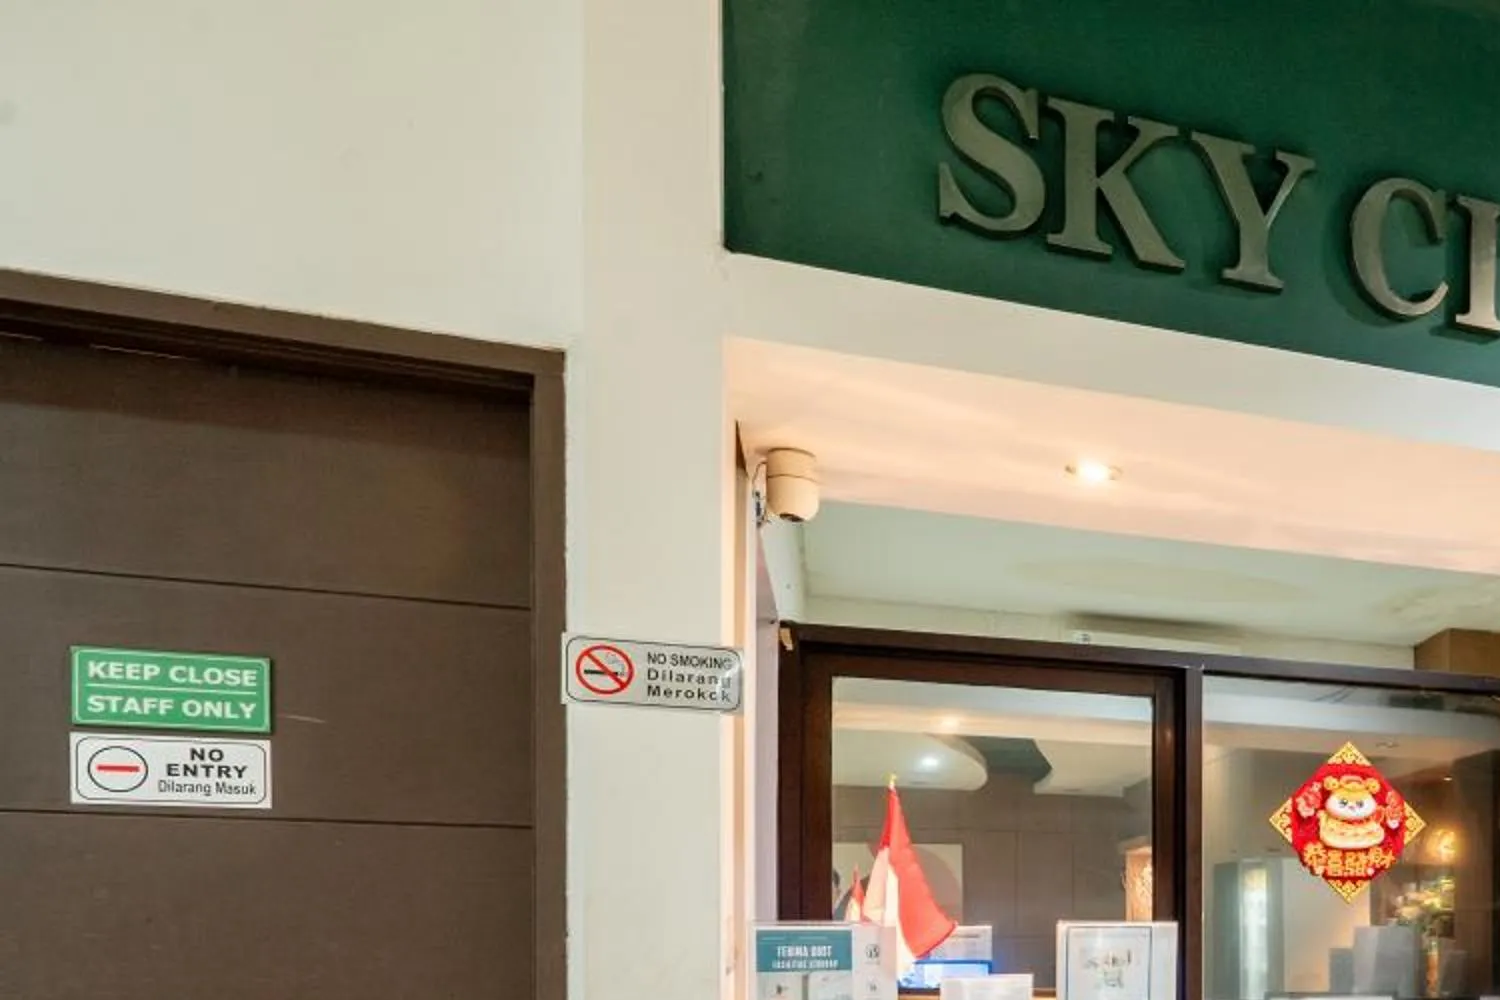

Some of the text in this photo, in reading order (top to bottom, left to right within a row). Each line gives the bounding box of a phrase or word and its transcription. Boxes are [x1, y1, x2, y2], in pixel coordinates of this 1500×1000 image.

[937, 72, 1316, 292] SKY
[647, 651, 733, 671] NO SMOKING
[87, 660, 258, 687] KEEP CLOSE
[647, 669, 732, 689] Dilarang
[647, 685, 731, 702] Merokok
[87, 695, 257, 720] STAFF ONLY
[190, 747, 224, 762] NO
[166, 763, 249, 779] ENTRY
[158, 779, 257, 797] Dilarang Masuk
